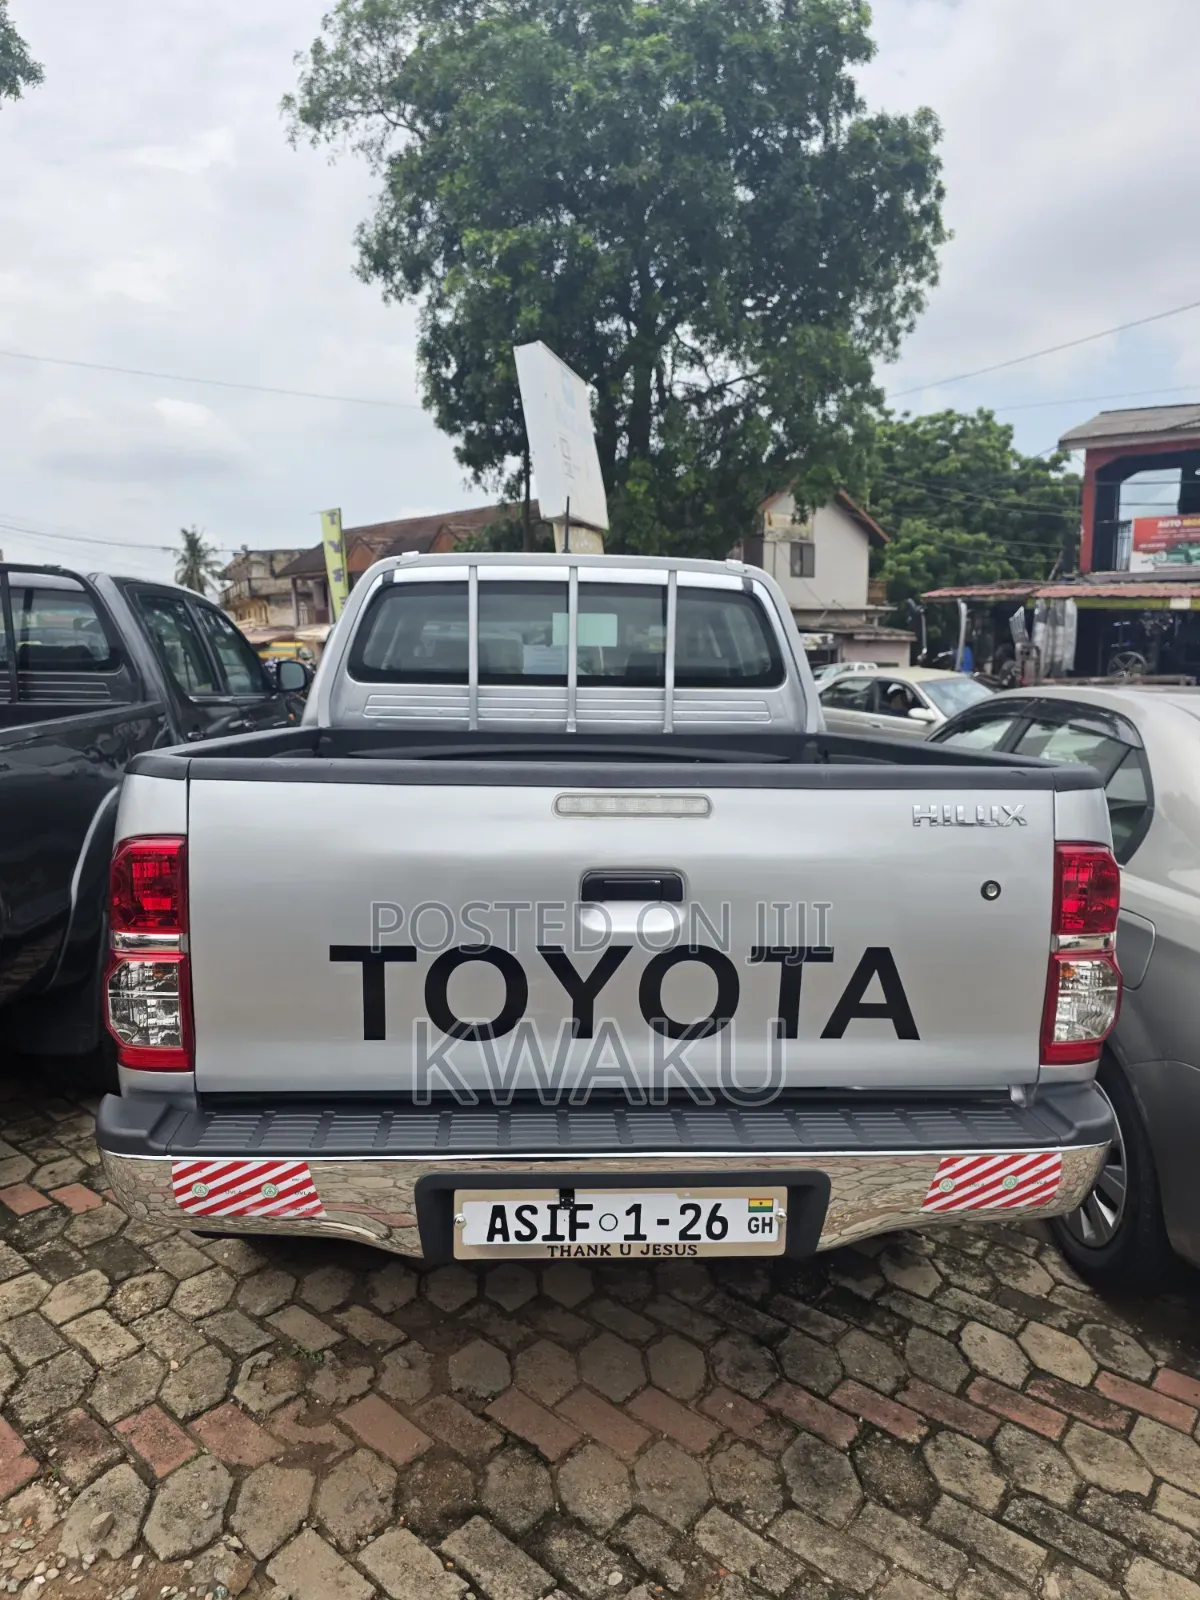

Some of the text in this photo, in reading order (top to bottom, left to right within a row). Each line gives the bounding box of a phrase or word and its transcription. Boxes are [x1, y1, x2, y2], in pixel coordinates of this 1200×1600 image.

[912, 804, 1028, 827] HILUX
[329, 944, 920, 1041] TOYOTA
[486, 1203, 594, 1242] ASIF
[747, 1217, 774, 1234] GH
[547, 1243, 698, 1257] THANK U JESUS
